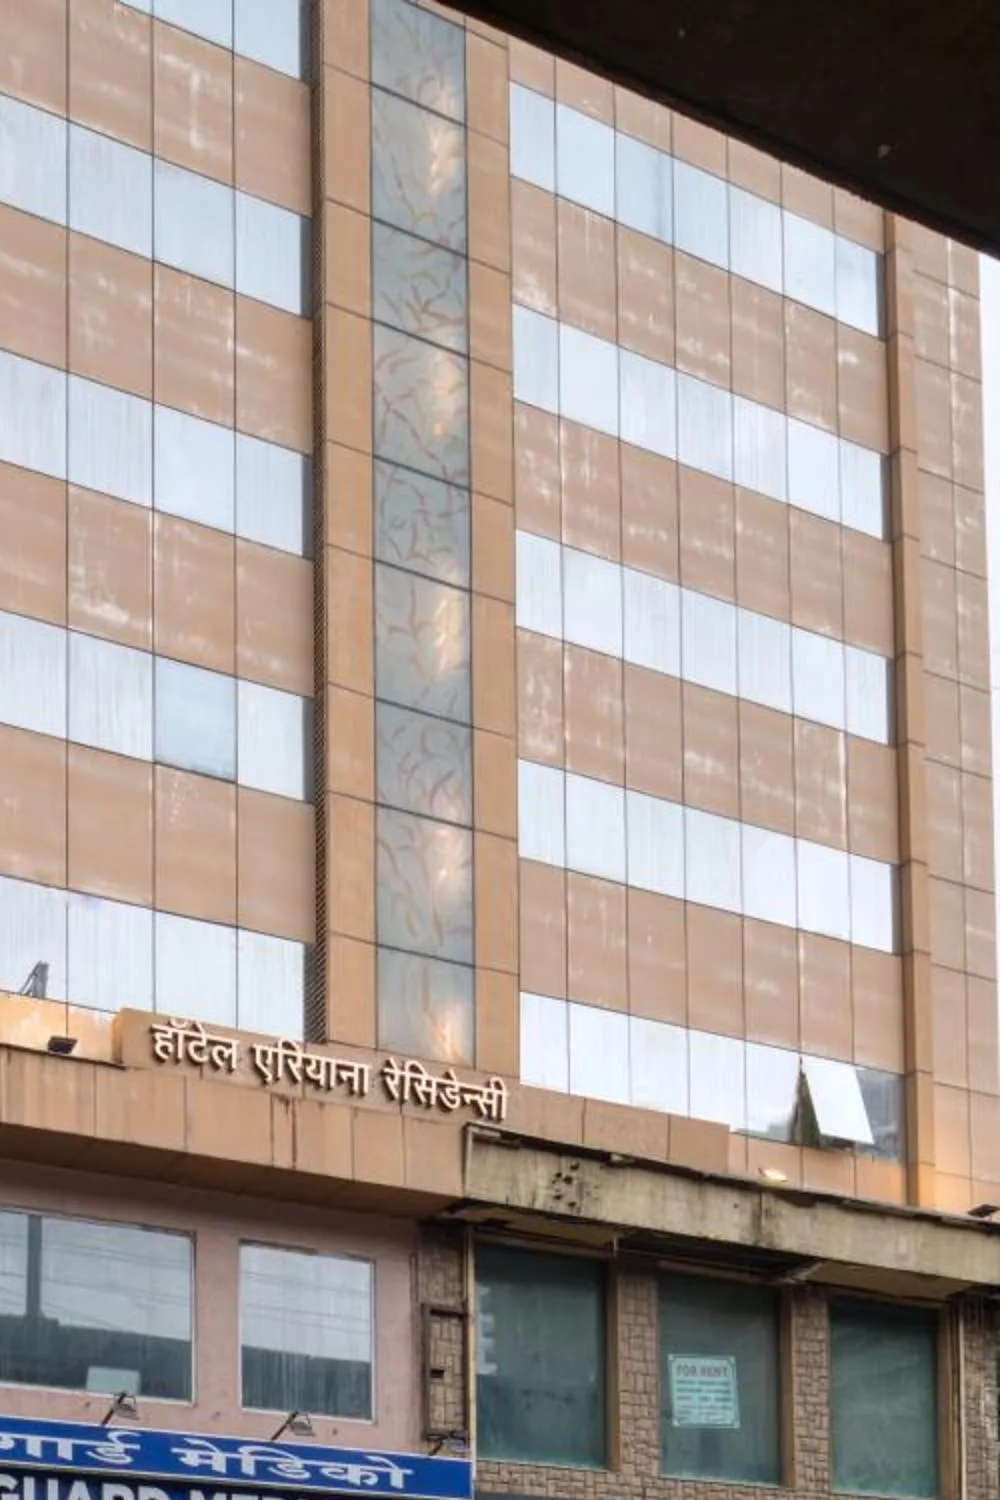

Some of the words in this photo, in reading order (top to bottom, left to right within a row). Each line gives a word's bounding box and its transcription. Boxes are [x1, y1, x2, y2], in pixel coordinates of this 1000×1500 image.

[150, 1018, 240, 1070] हॉटेल
[251, 1037, 372, 1094] एरियाना
[382, 1056, 509, 1120] रेसिडेन्सी
[171, 1437, 414, 1489] मेडिको
